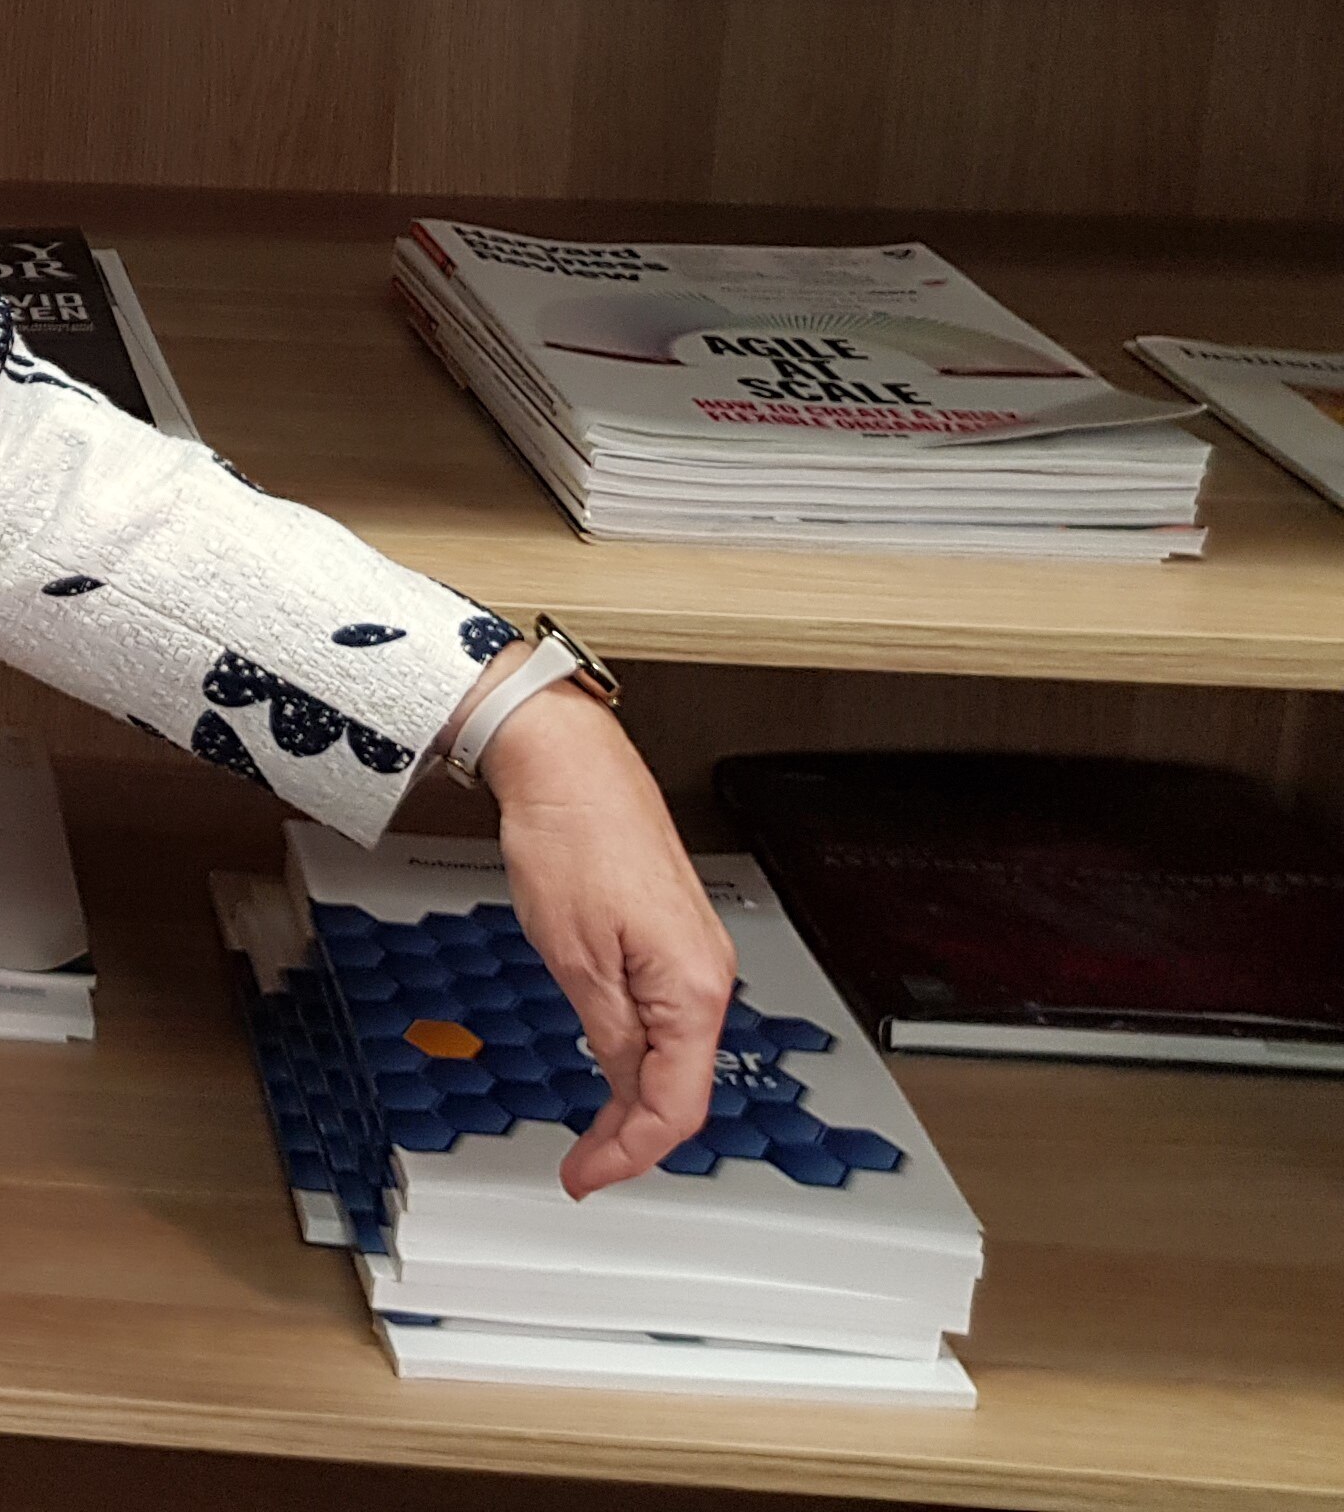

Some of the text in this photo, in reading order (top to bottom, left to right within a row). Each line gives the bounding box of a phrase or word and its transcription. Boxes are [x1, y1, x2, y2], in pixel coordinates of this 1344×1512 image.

[701, 335, 869, 360] AGILE
[771, 358, 843, 382] AT
[736, 378, 933, 407] SCALE
